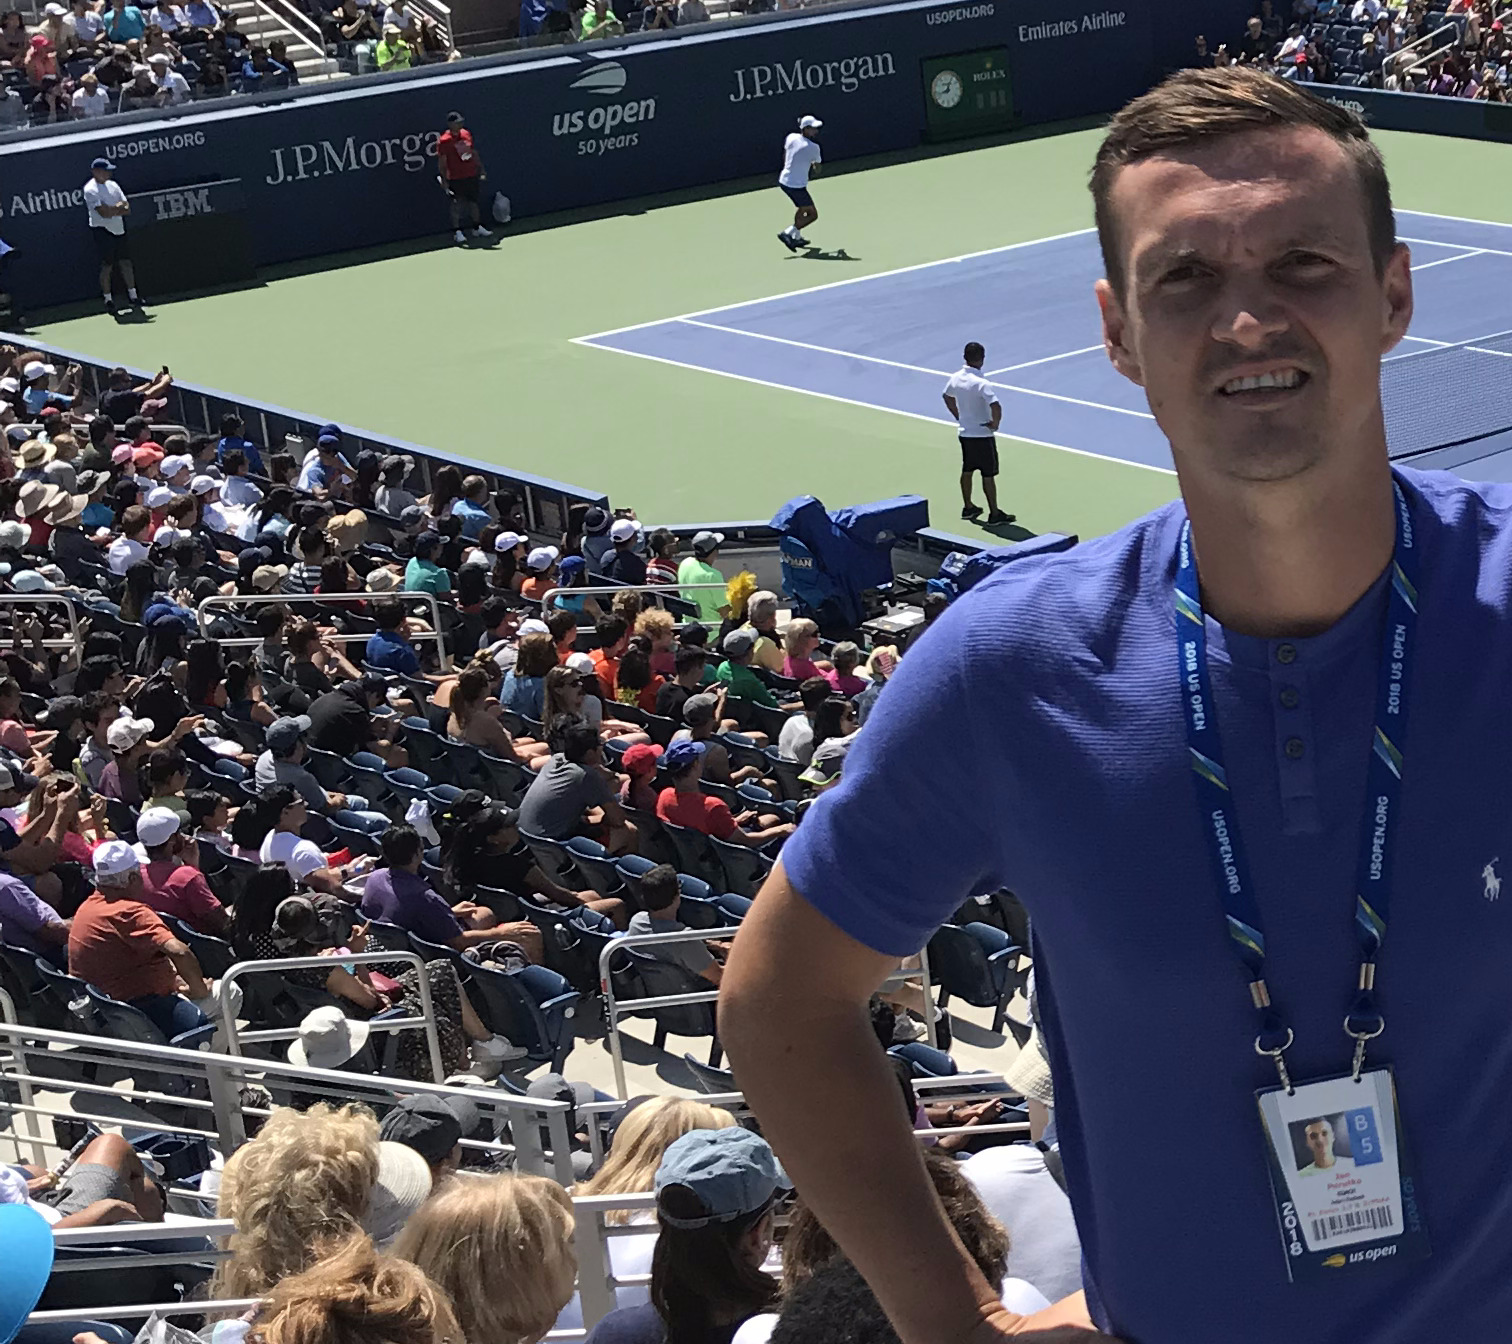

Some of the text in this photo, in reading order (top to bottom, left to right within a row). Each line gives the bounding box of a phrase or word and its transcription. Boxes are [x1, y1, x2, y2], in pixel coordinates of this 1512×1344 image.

[926, 3, 995, 26] USOPEN.ORG
[1018, 8, 1127, 43] Emirates Airline
[728, 50, 896, 103] J.P.Morgan
[973, 68, 1006, 82] ROLEX
[552, 97, 656, 137] us open
[105, 131, 206, 160] USOPEN.ORG
[265, 130, 442, 186] J.P.Morga
[577, 132, 640, 158] 50 years
[153, 188, 213, 221] IBM
[1184, 641, 1206, 731] 2018 US OPEN
[1387, 624, 1407, 715] 2018 US OPEN
[1211, 809, 1242, 895] USOPEN.ORG
[1370, 795, 1389, 880] USOPEN.ORG
[1362, 1138, 1373, 1154] 5
[1282, 1201, 1304, 1256] 2018
[1349, 1244, 1398, 1264] us open
